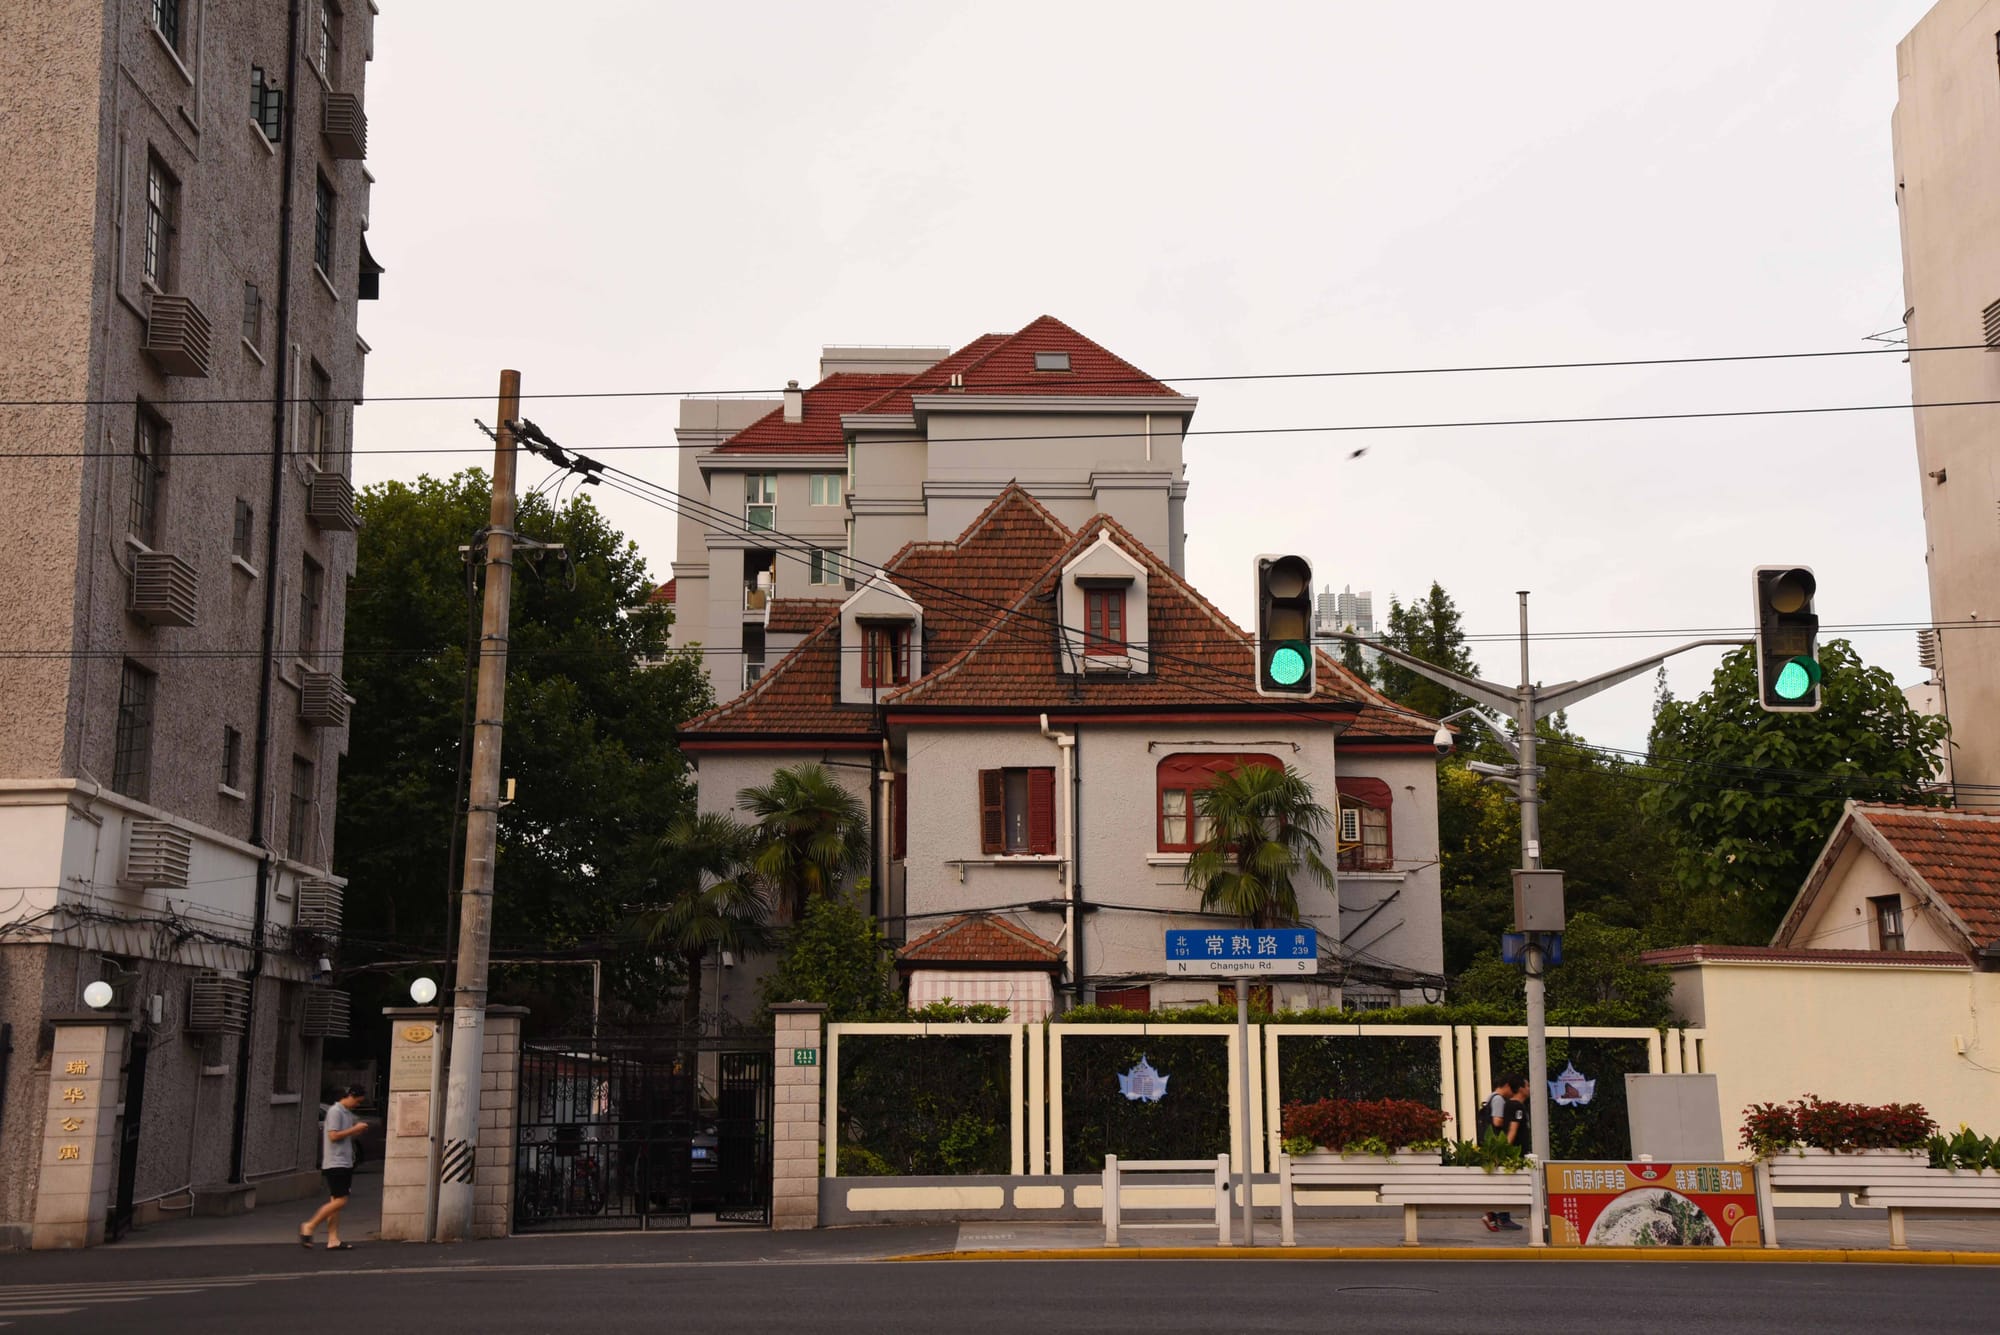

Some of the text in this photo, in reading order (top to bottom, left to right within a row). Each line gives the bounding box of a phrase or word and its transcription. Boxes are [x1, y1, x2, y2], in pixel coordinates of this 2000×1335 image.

[1177, 936, 1187, 946] 北
[1295, 935, 1305, 945] 南
[1205, 934, 1278, 956] 常熟路
[1175, 948, 1190, 956] 191
[1292, 947, 1309, 955] 239
[1179, 963, 1187, 971] N
[1210, 962, 1255, 971] Changshu
[1298, 961, 1305, 970] S
[797, 1051, 813, 1060] 211
[58, 1060, 89, 1160] 瑞华公寓
[1563, 1169, 1626, 1190] 几间茅庐草舍
[1675, 1167, 1743, 1192] 装满和谐乾坤
